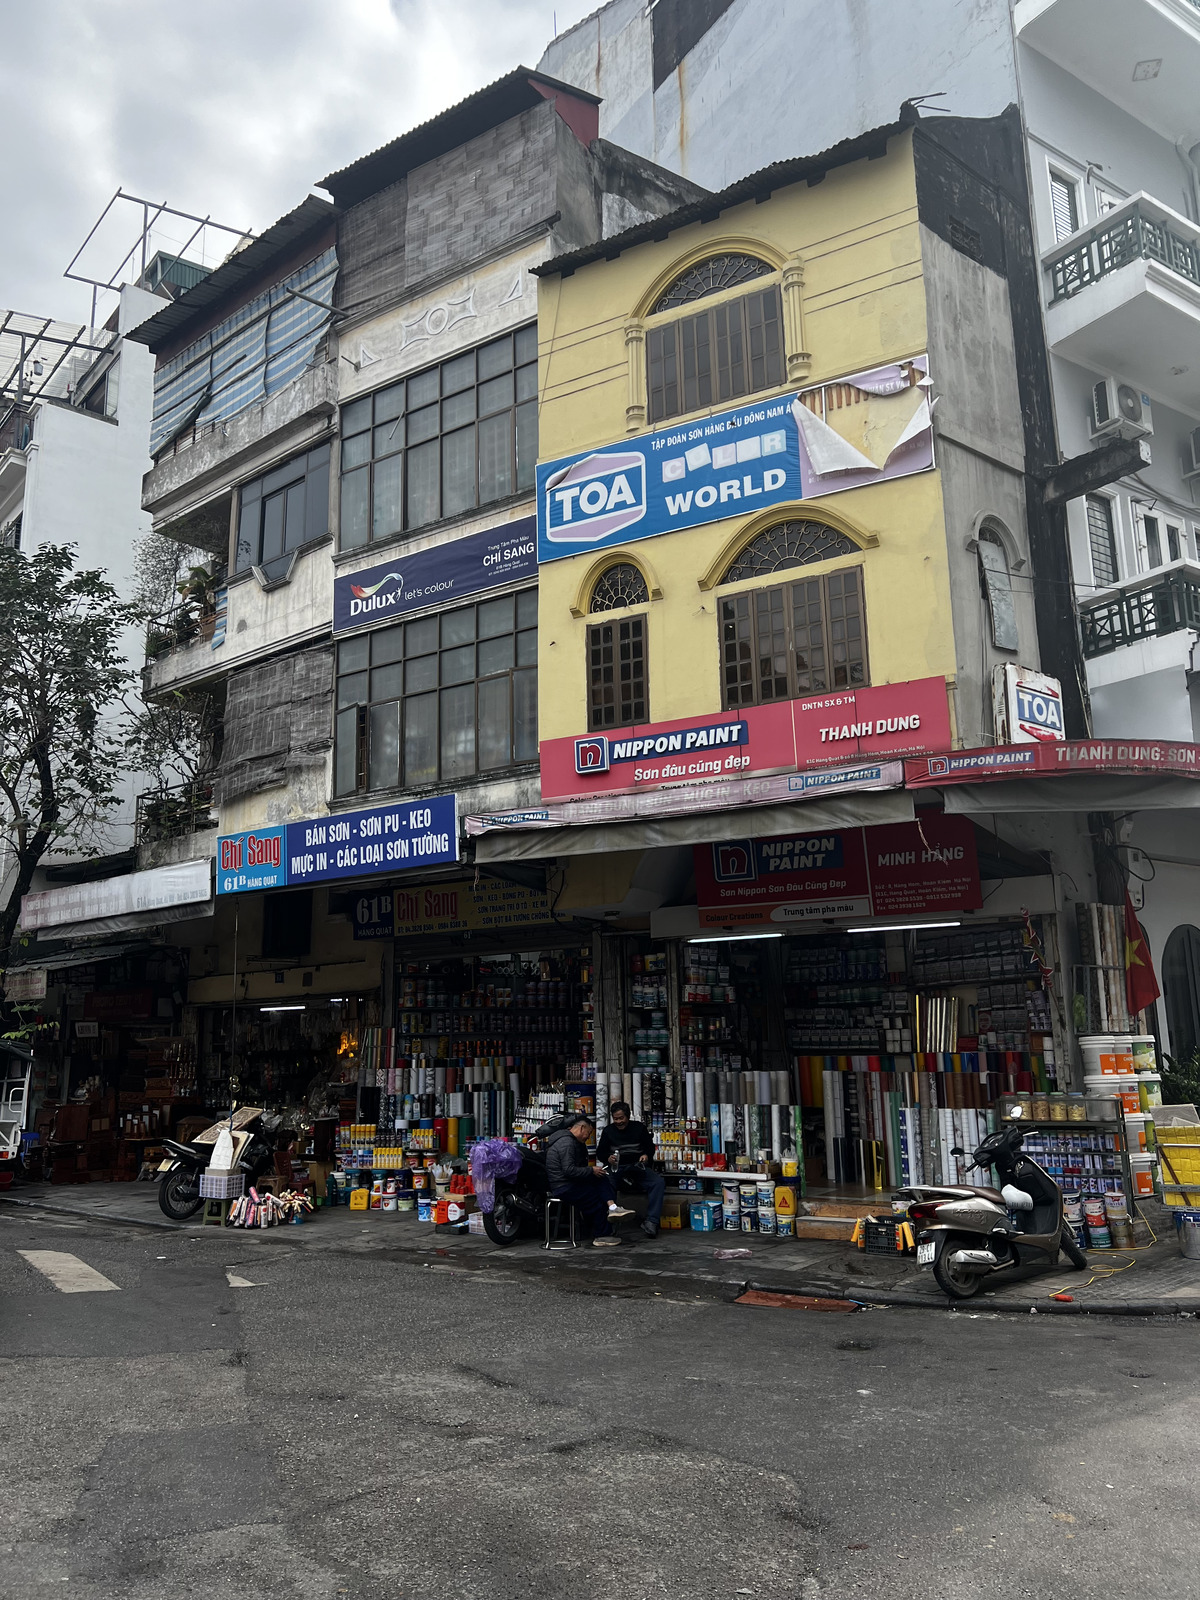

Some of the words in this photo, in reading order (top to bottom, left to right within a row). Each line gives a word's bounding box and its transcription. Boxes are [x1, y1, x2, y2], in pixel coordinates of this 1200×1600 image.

[651, 438, 666, 451] TẬP
[667, 432, 687, 447] ĐOÀN
[688, 427, 703, 441] SƠN
[704, 422, 725, 436] HÀNG
[744, 410, 766, 425] ĐÔNG
[766, 405, 784, 420] NAM
[556, 474, 636, 522] TOA
[664, 468, 788, 516] WORLD
[483, 550, 502, 566] CHÍ
[504, 542, 534, 560] SANG
[404, 582, 423, 601] let's
[424, 578, 455, 596] colour
[350, 590, 402, 617] Dulux
[802, 701, 824, 711] DNTN
[824, 698, 836, 708] SX
[836, 698, 843, 706] &
[844, 696, 856, 704] TM
[1018, 694, 1061, 728] TOA
[820, 721, 873, 742] THANH
[876, 714, 920, 734] DUNG
[613, 730, 682, 760] NIPPON
[686, 724, 743, 749] PAINT
[952, 755, 994, 769] NIPPON
[996, 752, 1032, 764] PAINT
[1056, 746, 1113, 761] THANH
[1117, 746, 1164, 761] DUNG:
[1168, 748, 1196, 764] SƠN
[634, 766, 660, 782] Sơn
[661, 762, 687, 778] đâu
[724, 755, 751, 772] đẹp
[807, 773, 846, 786] NIPPON
[848, 770, 878, 782] PAINT
[306, 826, 326, 846] BÁN
[329, 823, 350, 842] SƠN
[360, 817, 382, 836] SƠN
[384, 814, 400, 833] PU
[410, 808, 432, 829] KEO
[221, 838, 245, 872] Chí
[247, 835, 282, 868] Sang
[292, 855, 314, 877] MỰC
[316, 852, 328, 872] IN
[336, 844, 358, 868] CÁC
[360, 845, 384, 867] LOẠI
[386, 838, 409, 860] SƠN
[412, 834, 450, 856] TƯỜNG
[762, 837, 836, 857] NIPPON
[878, 850, 916, 867] MINH
[769, 854, 826, 872] PAINT
[224, 876, 246, 890] 61B
[248, 876, 262, 888] HÀNG
[263, 874, 278, 887] QUẠT
[720, 888, 736, 897] Sơn
[738, 885, 766, 896] Nippon
[768, 884, 785, 894] Sơn
[397, 889, 420, 922] Chí
[424, 889, 458, 920] Sang
[518, 890, 525, 899] PU
[356, 895, 392, 925] 61B
[705, 914, 728, 922] Colour
[730, 912, 764, 921] Creations
[783, 908, 804, 917] Trung
[806, 906, 820, 914] tâm
[822, 906, 836, 915] pha
[838, 904, 854, 912] màu
[358, 927, 375, 937] HÀNG
[376, 926, 392, 936] QUẠT
